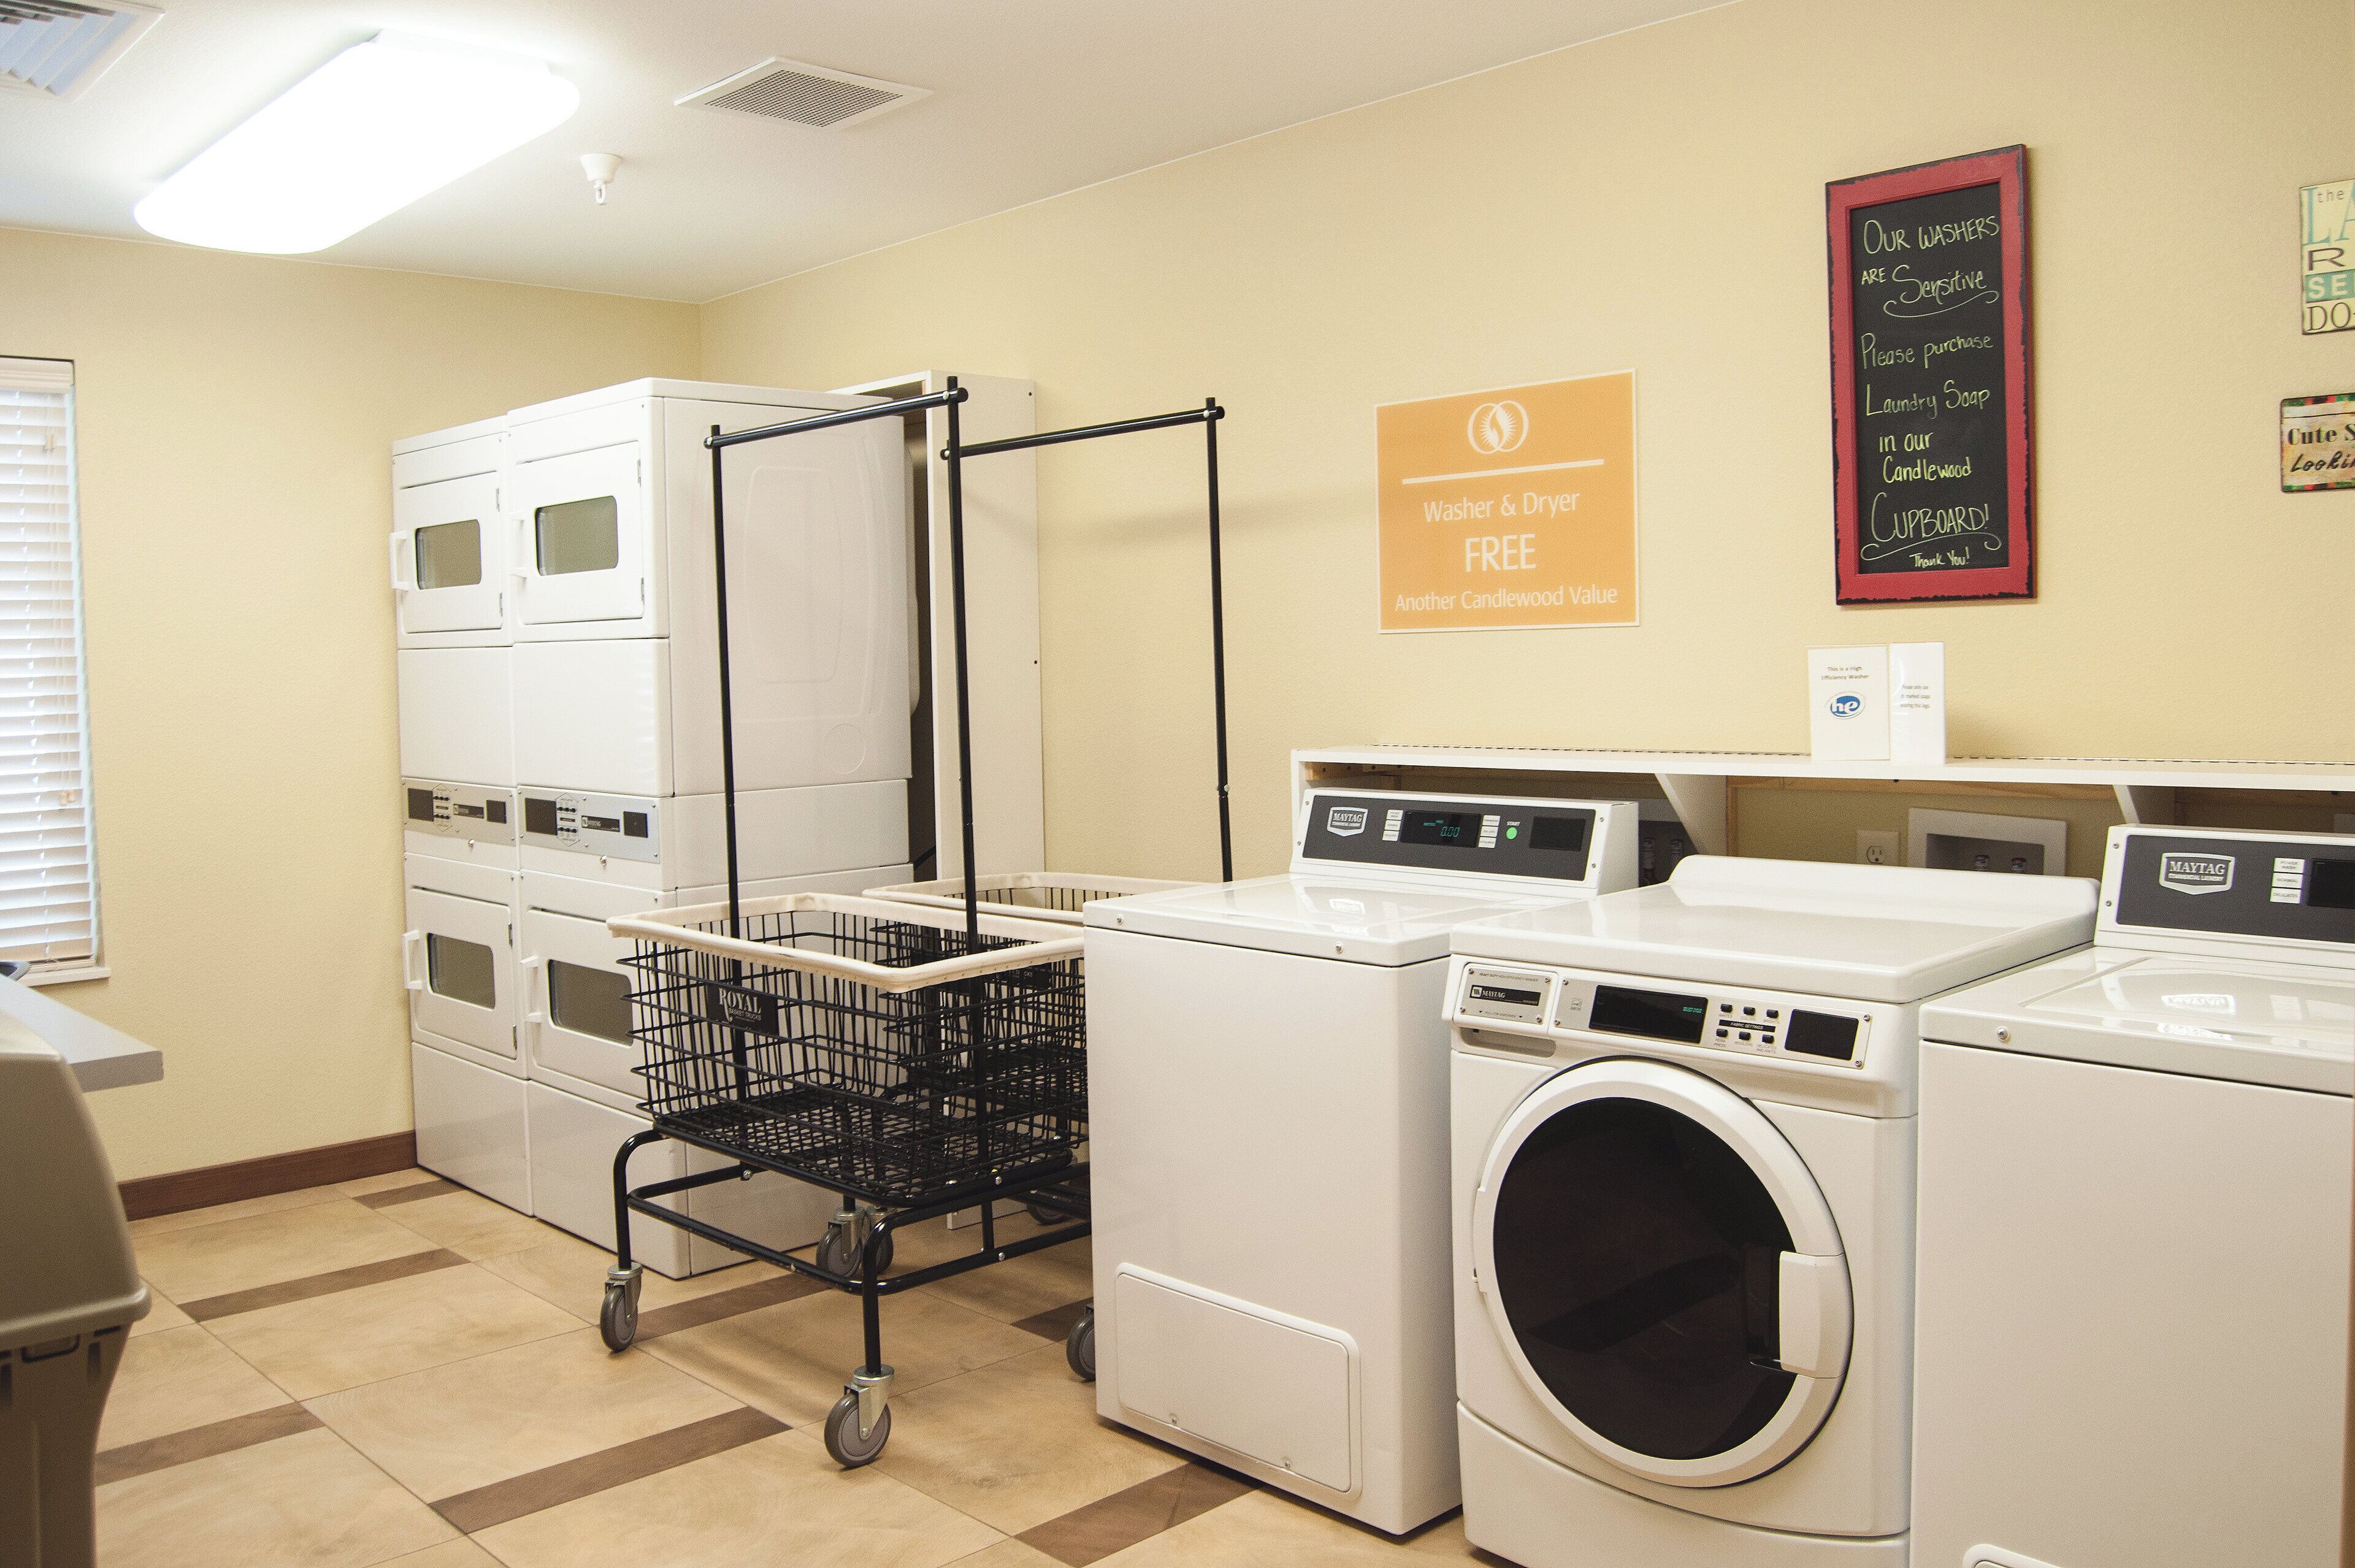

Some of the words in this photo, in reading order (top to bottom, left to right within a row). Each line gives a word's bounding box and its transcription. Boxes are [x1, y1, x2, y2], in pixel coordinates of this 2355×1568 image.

[2316, 189, 2345, 203] the
[1918, 215, 2001, 250] WASHERS
[2307, 247, 2346, 271] R
[1861, 267, 1887, 285] ARE
[1891, 264, 1988, 305] Sensitive
[2308, 273, 2355, 299] SE
[2307, 302, 2355, 331] DO
[1861, 332, 1915, 369] Please
[1923, 335, 1994, 369] purchase
[1866, 384, 1938, 419] Laundry
[1943, 380, 1991, 410] Soap
[1878, 432, 1896, 453] in
[1904, 432, 1934, 452] our
[2288, 427, 2337, 445] Cute
[1883, 455, 1972, 483] Candlewood
[1423, 497, 1495, 522] Washer
[1500, 493, 1517, 517] &
[1523, 492, 1580, 519] Dryer
[1465, 532, 1537, 572] FREE
[1909, 553, 1946, 568] Thank
[1947, 546, 1970, 566] You!
[1395, 591, 1457, 612] Another
[1461, 584, 1564, 610] Candlewood
[1569, 584, 1618, 605] Value
[1333, 812, 1363, 822] MAYTAG
[2169, 861, 2226, 875] MAYTAG
[719, 988, 762, 1022] ROYAL
[1480, 990, 1506, 998] MAYTAG
